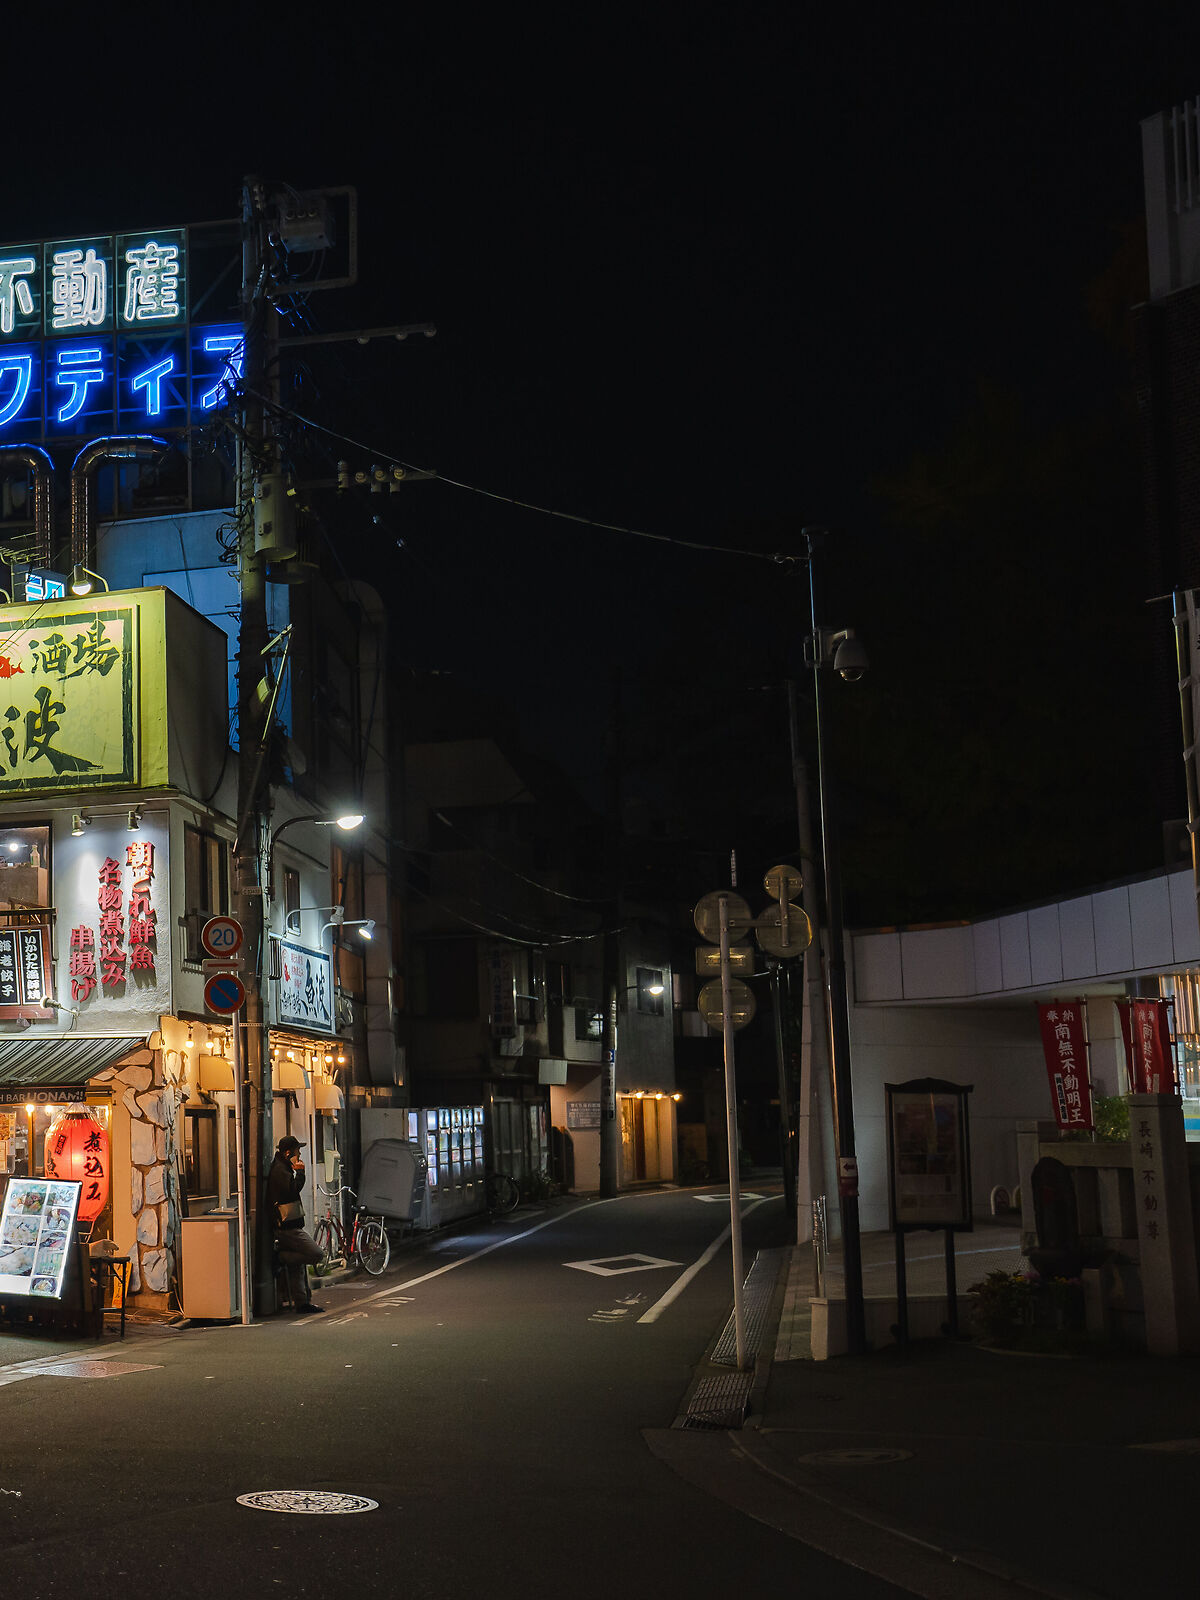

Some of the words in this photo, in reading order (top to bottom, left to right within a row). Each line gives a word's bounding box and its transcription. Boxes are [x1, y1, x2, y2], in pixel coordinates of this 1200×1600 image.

[28, 619, 121, 682] 酒場
[98, 856, 127, 988] 名物煮込み
[212, 928, 235, 947] 20
[0, 939, 15, 998] 海老餃子
[69, 924, 97, 1003] 串揚げ
[6, 1093, 25, 1102] BAR
[1054, 1022, 1086, 1124] 南無不動明王
[1138, 1120, 1160, 1241] 長崎不動尊
